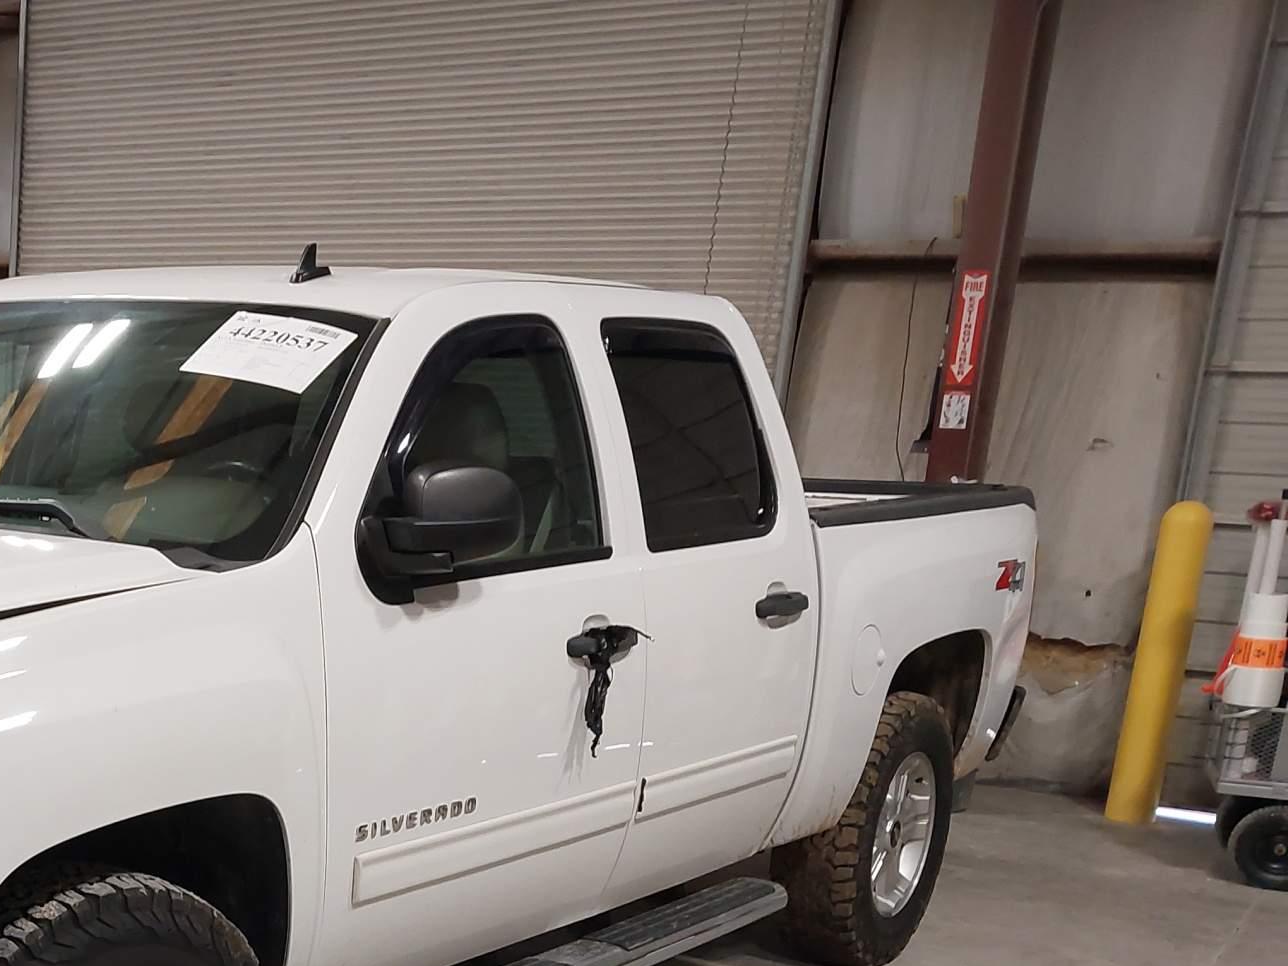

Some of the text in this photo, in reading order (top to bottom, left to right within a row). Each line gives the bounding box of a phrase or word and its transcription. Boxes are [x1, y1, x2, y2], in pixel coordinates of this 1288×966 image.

[964, 280, 985, 292] FIRE
[229, 326, 329, 352] 44220537
[354, 797, 477, 842] SILVERADO
